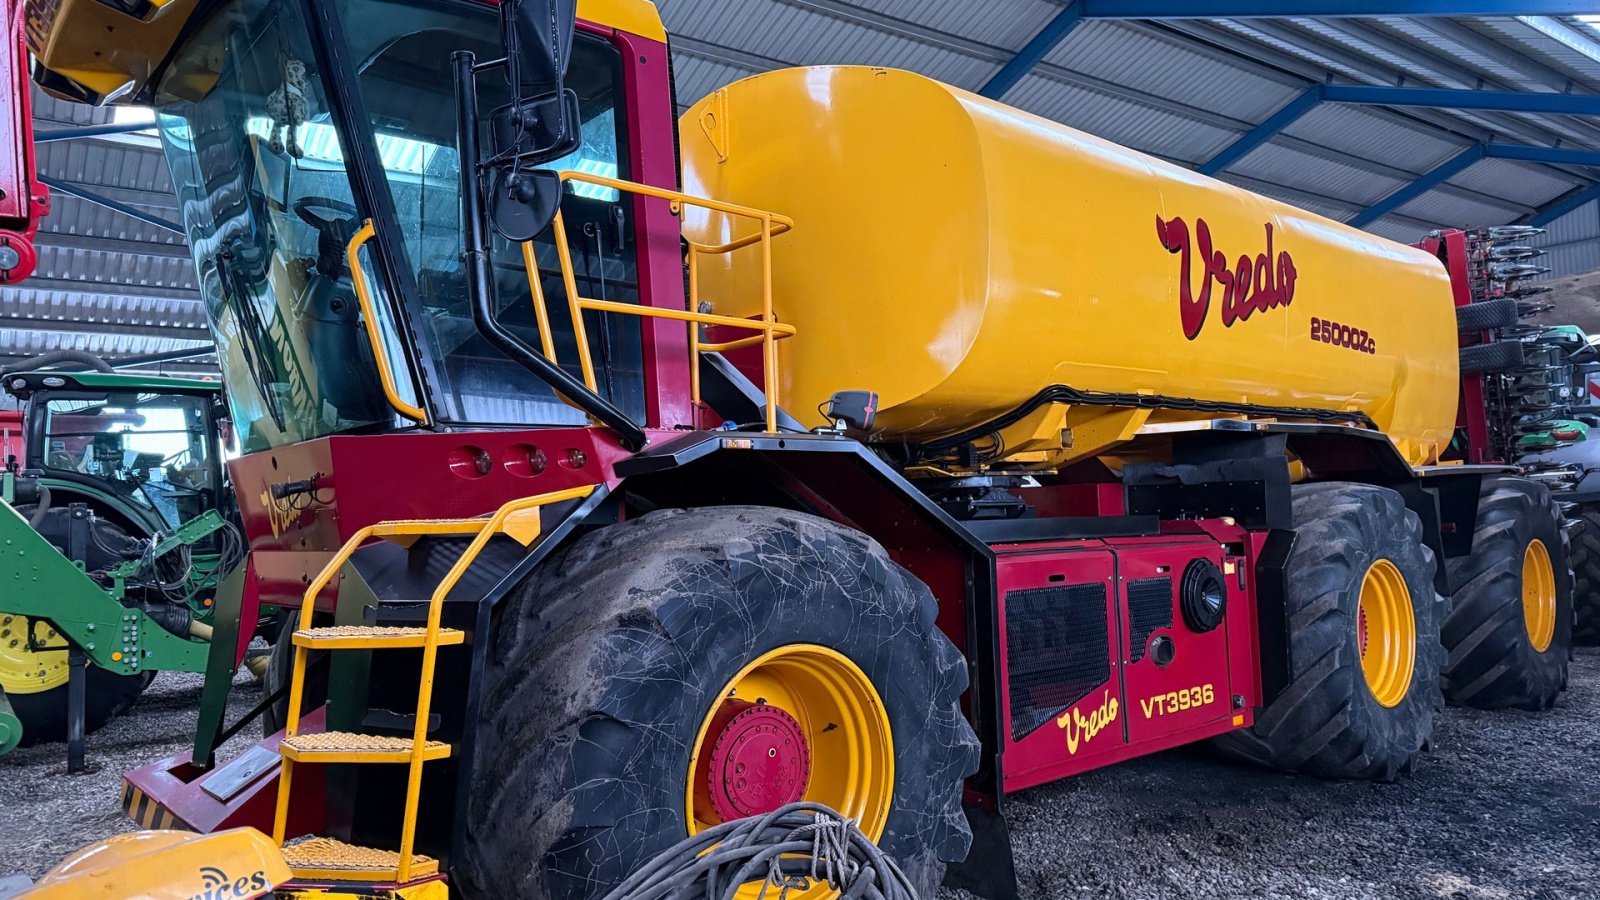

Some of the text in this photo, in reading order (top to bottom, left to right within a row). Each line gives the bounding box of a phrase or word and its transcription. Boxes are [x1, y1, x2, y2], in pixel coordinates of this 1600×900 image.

[1156, 214, 1297, 340] Vredo
[1057, 689, 1119, 755] Vredo
[1140, 683, 1214, 719] VT3936
